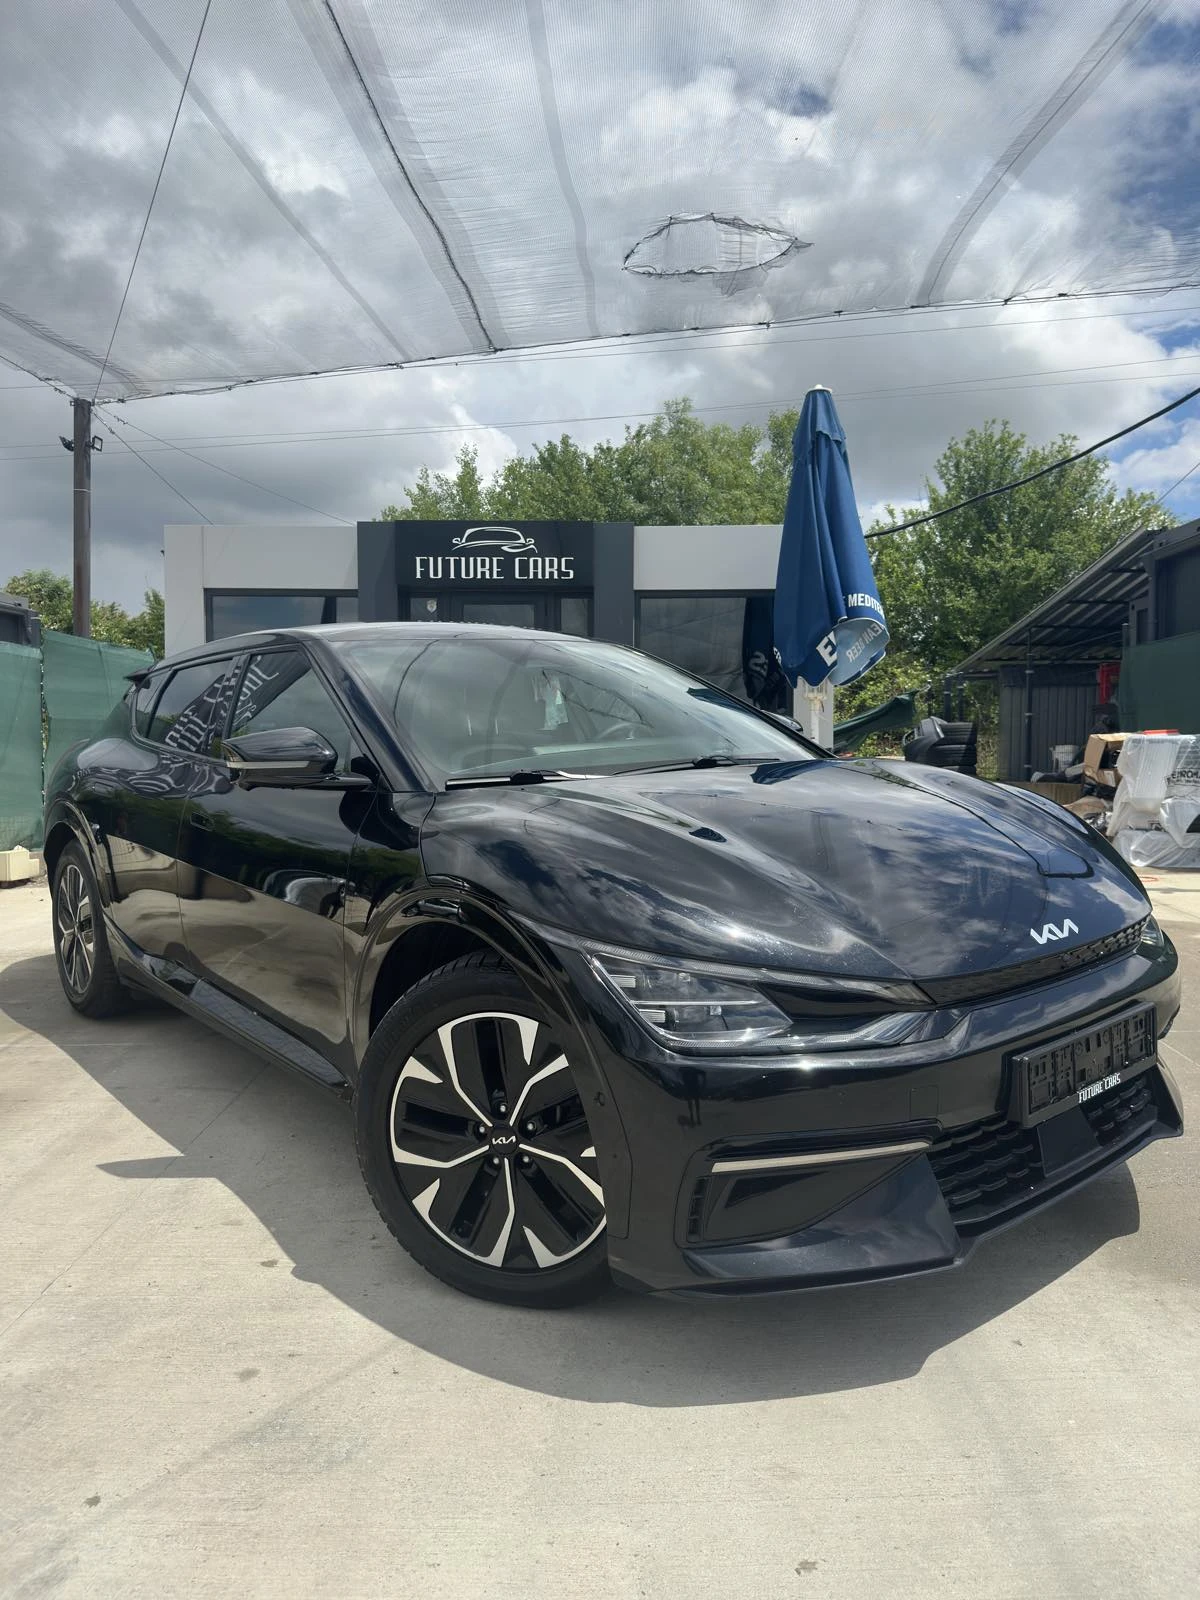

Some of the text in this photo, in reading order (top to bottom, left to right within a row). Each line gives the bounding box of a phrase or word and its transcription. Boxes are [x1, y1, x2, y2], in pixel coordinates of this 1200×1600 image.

[415, 556, 575, 579] FUTURE CARS
[1030, 918, 1079, 945] KIA
[1077, 1072, 1121, 1104] FUTURE CARS
[492, 1135, 517, 1145] KIA
